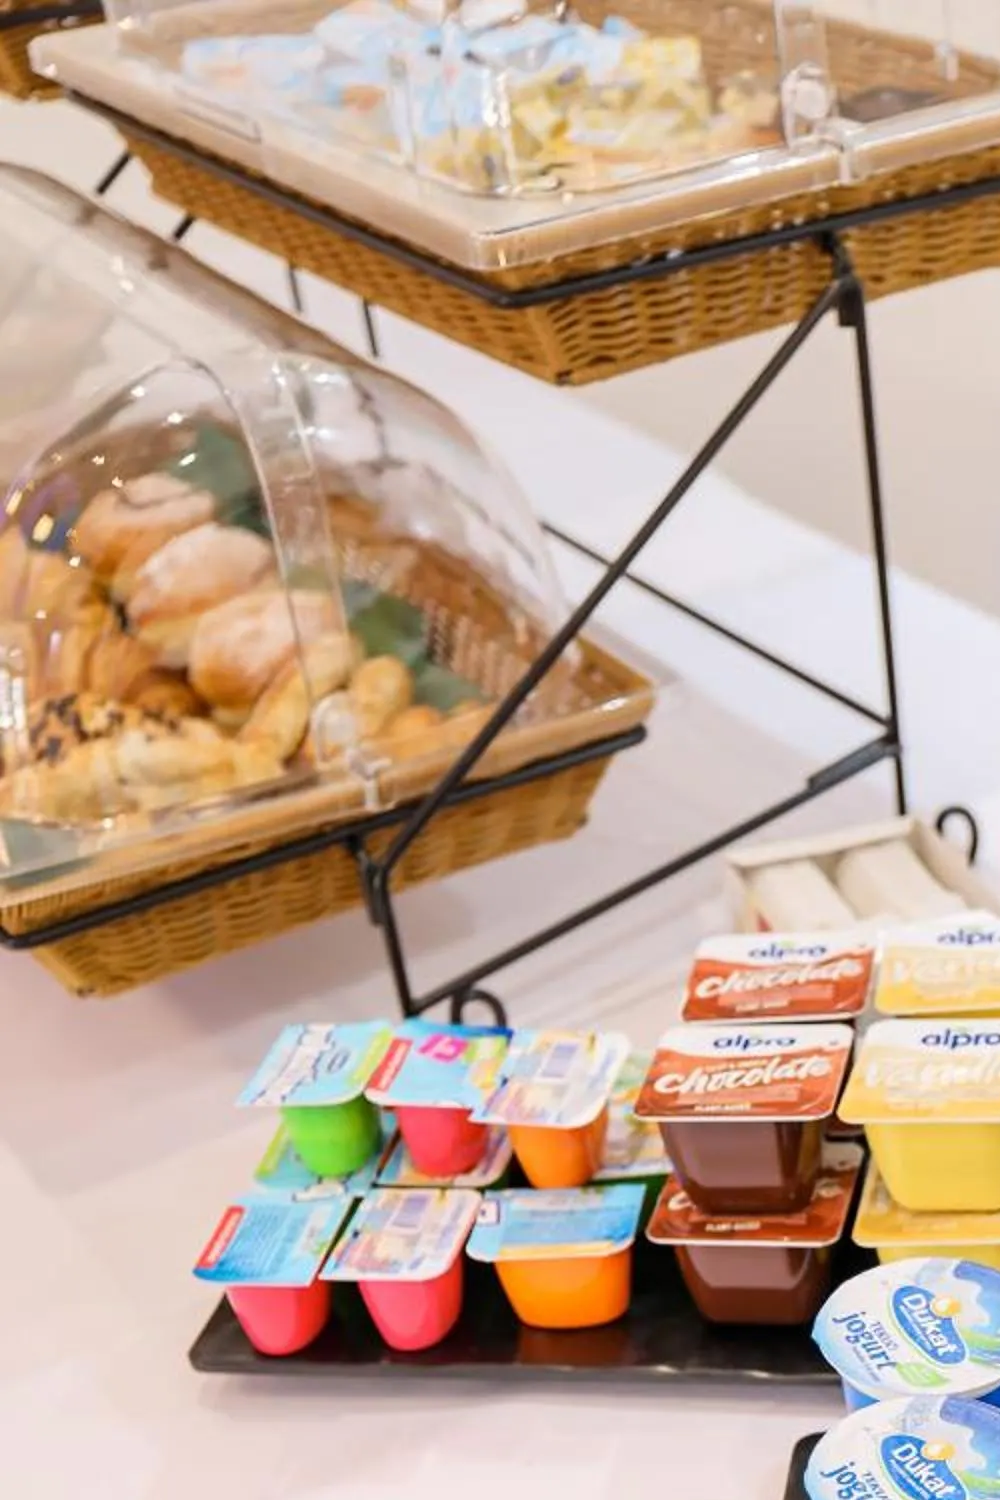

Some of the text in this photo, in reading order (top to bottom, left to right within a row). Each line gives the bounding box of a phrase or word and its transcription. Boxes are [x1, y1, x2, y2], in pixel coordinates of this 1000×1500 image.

[713, 1034, 796, 1050] alpro
[653, 1055, 832, 1094] Chocolate
[832, 1311, 898, 1370] jogurt
[902, 1293, 959, 1356] Dukat
[891, 1443, 956, 1498] Dukat
